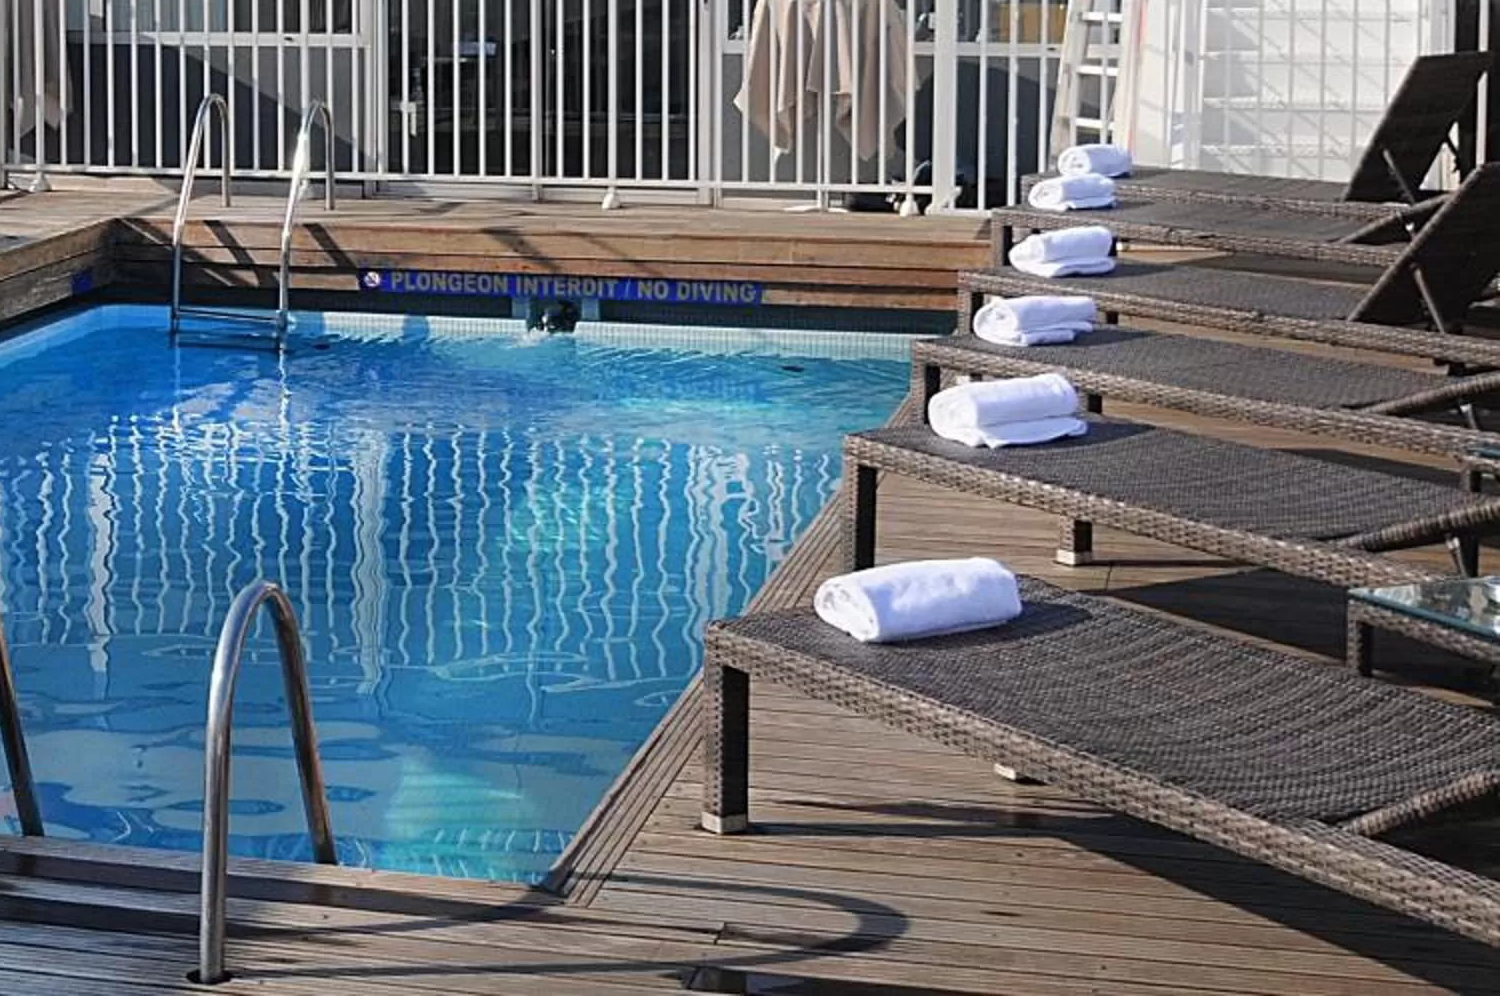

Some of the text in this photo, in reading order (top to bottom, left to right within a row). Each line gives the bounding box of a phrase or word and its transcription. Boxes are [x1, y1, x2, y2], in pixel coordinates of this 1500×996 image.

[391, 271, 509, 294] PLONGEON
[515, 275, 619, 298] INTERDIT
[637, 280, 669, 300] NO
[676, 281, 756, 303] DIVING
